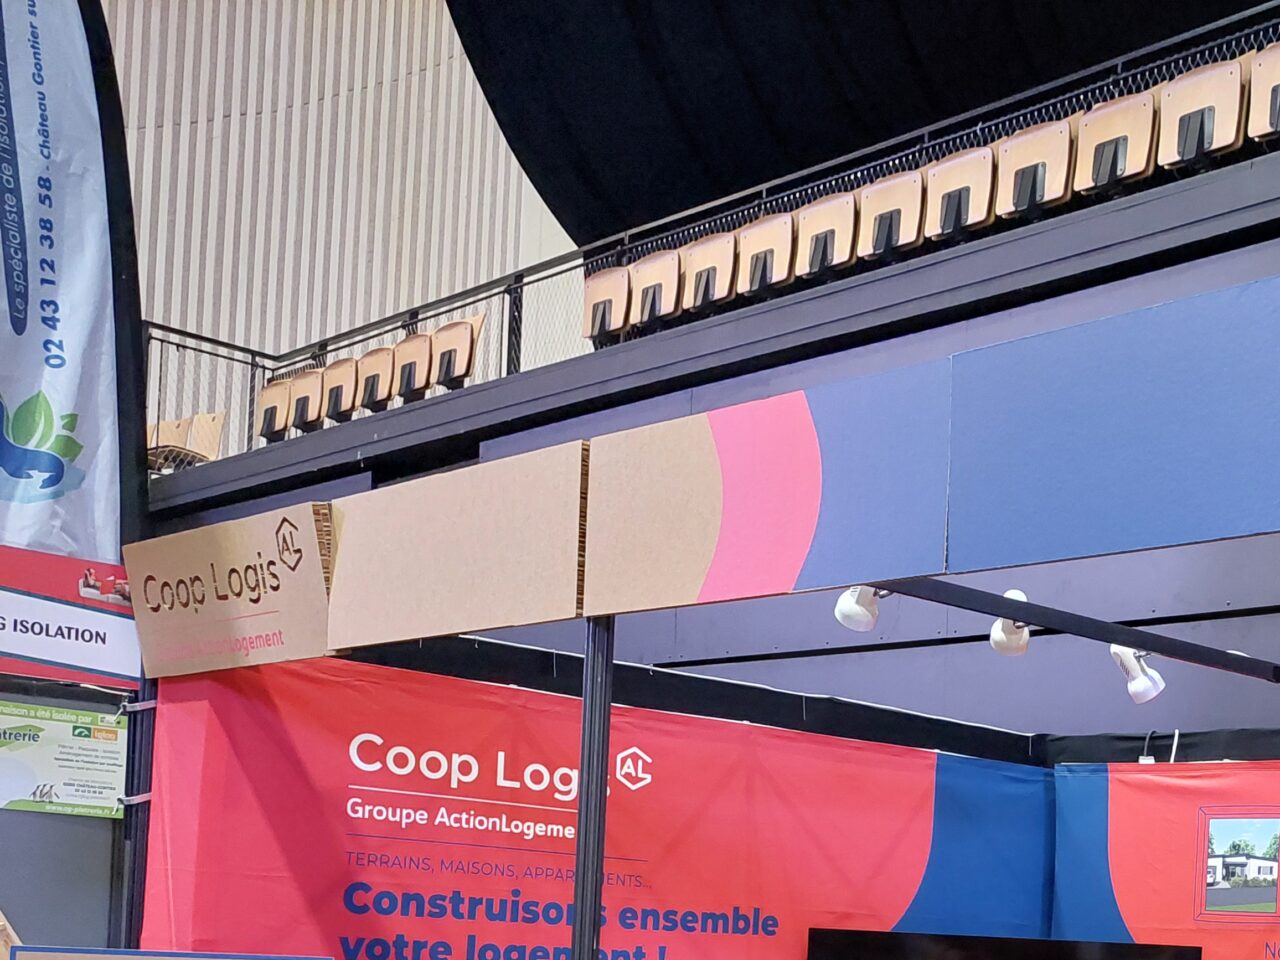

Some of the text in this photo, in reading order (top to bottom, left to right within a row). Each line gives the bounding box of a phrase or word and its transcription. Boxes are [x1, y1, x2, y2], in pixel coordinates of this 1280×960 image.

[27, 22, 44, 86] Gontier
[37, 91, 51, 161] Château
[2, 162, 15, 189] de
[37, 176, 53, 208] 58
[4, 193, 27, 293] spécialiste
[39, 217, 54, 250] 38
[40, 258, 57, 286] 12
[13, 297, 26, 319] Le
[40, 299, 61, 331] 43
[43, 338, 66, 369] 02
[143, 551, 281, 614] Coop Logis
[13, 618, 107, 646] ISOLATION
[36, 708, 51, 718] été
[51, 709, 77, 721] isolée
[77, 715, 93, 724] par
[348, 732, 479, 789] Coop
[496, 750, 611, 801] Log
[346, 797, 577, 840] Groupe ActionLogeme
[346, 851, 653, 889] TERRAINS, MAISONS, APPARENTS...
[619, 896, 779, 936] ensemble
